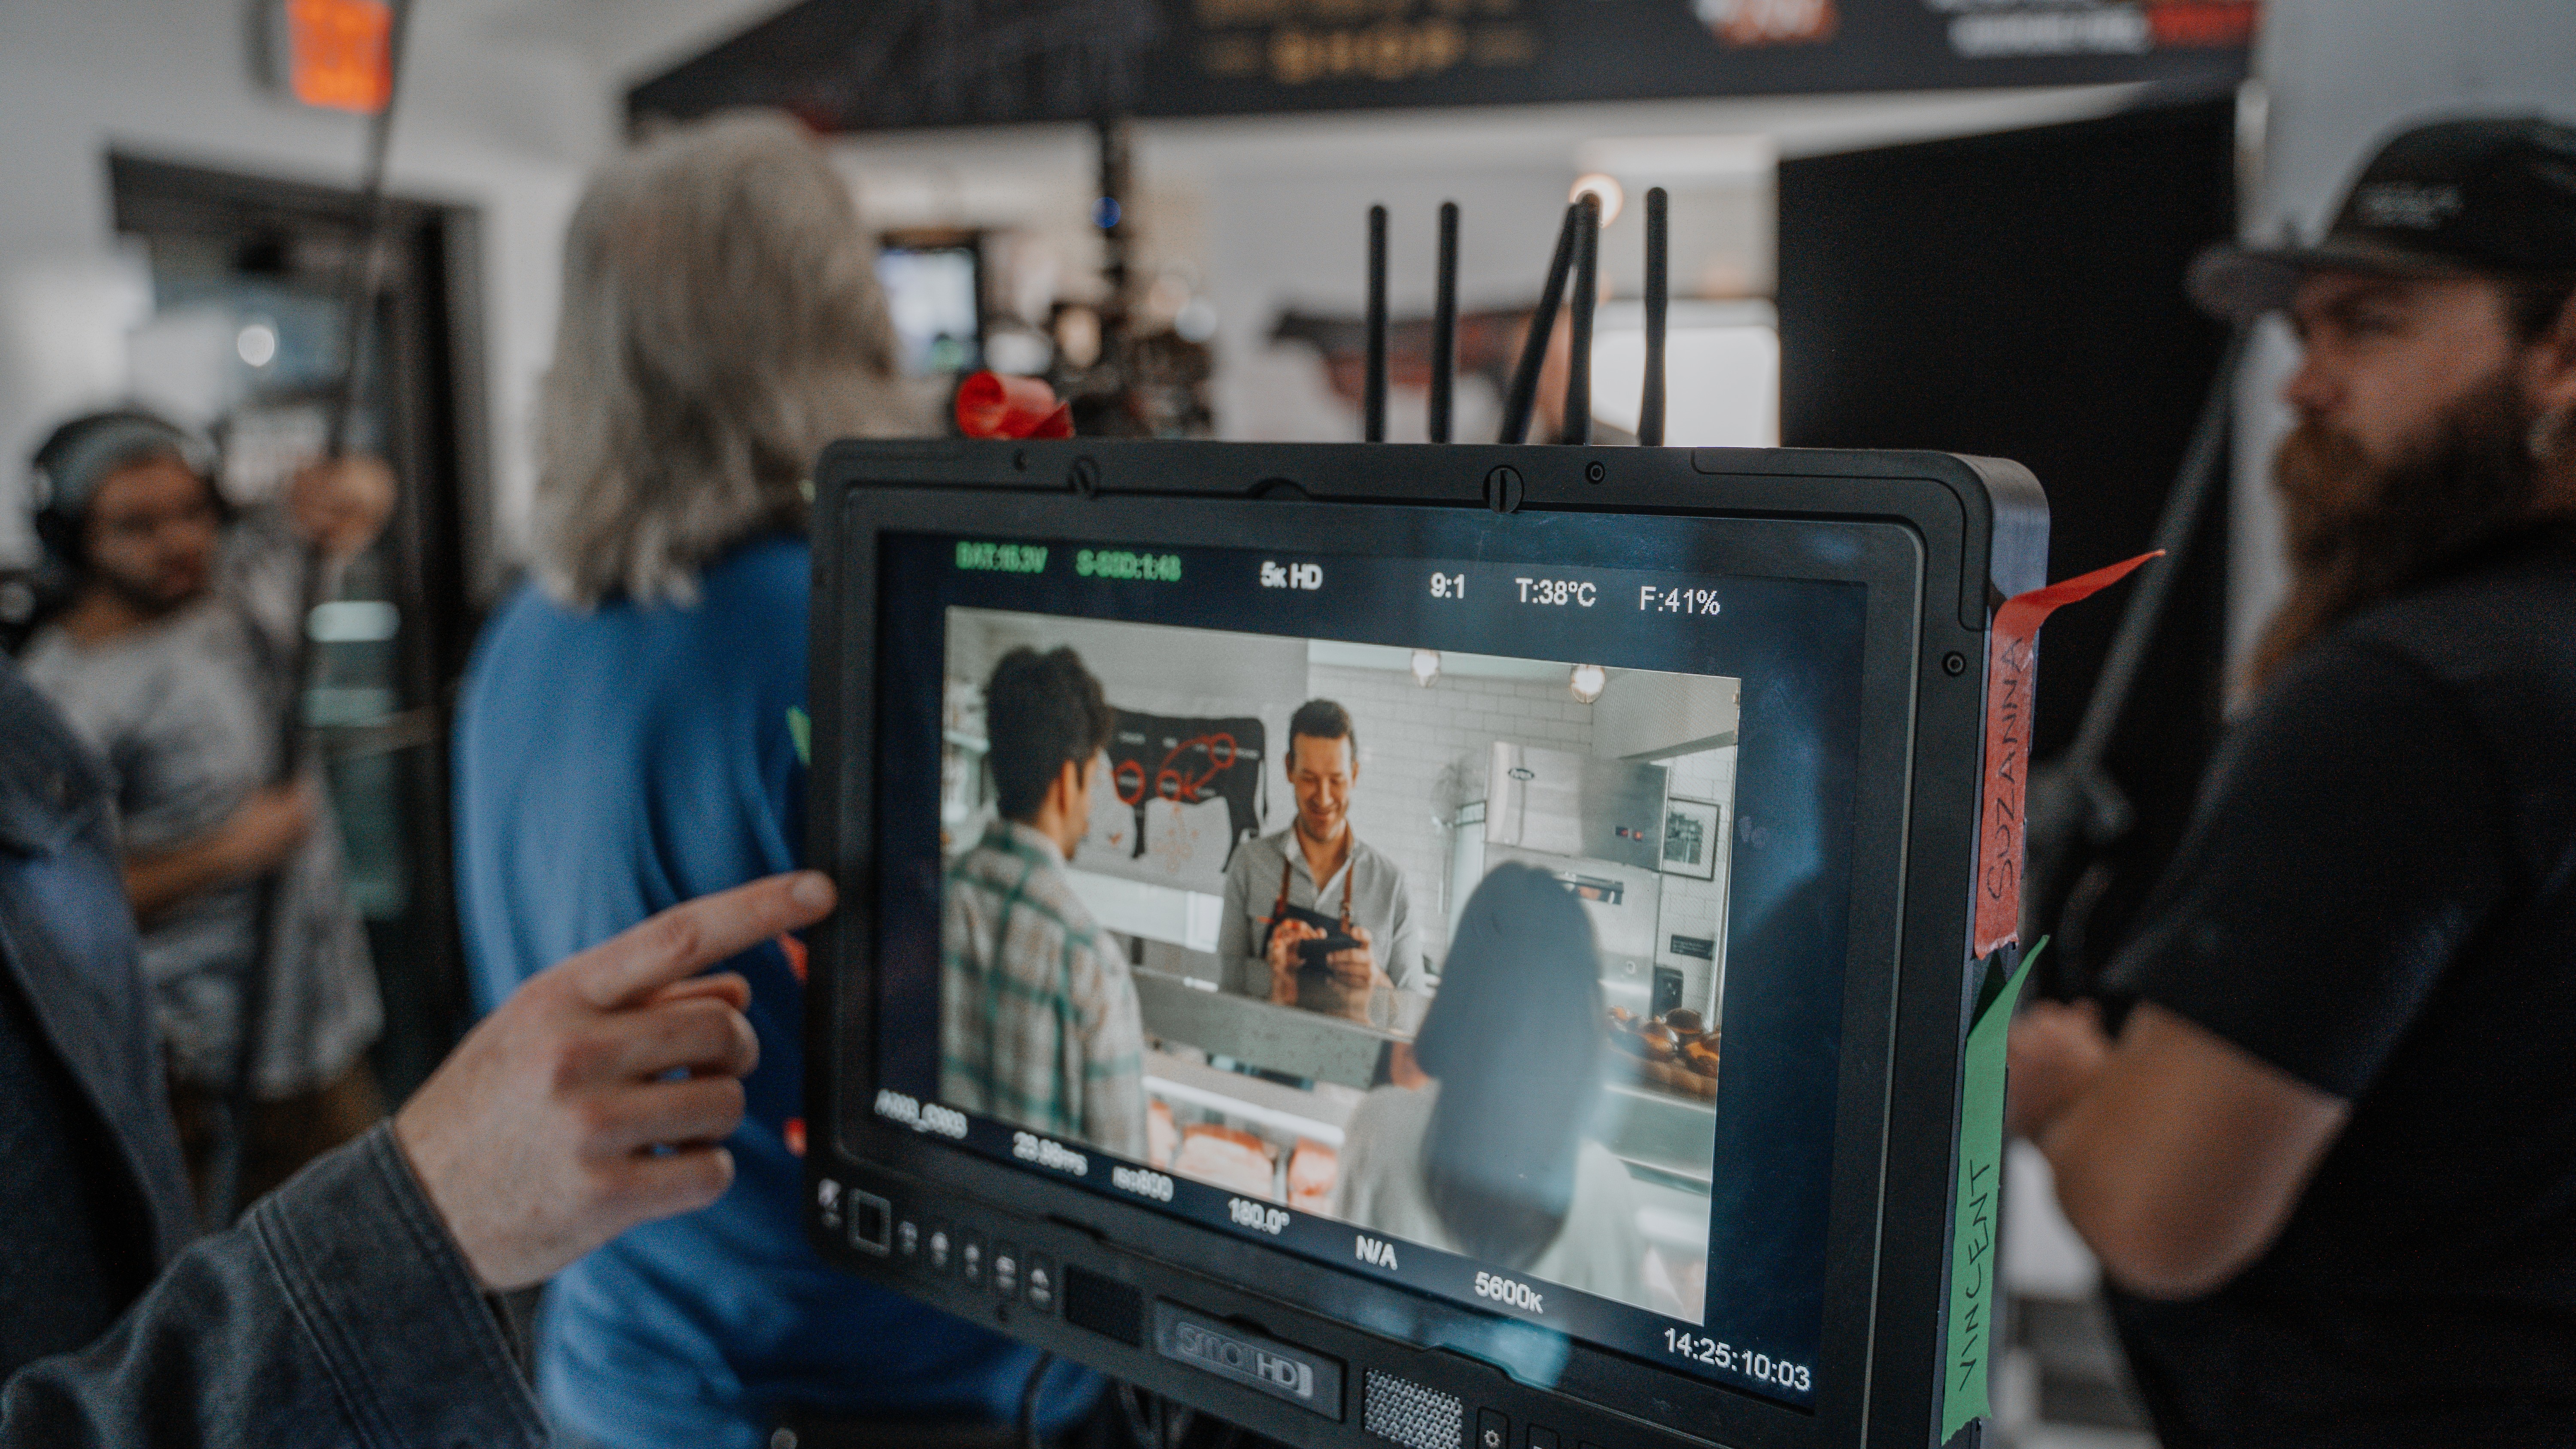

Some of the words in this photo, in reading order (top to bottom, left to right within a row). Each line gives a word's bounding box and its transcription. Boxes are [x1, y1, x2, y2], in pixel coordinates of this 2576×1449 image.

[1290, 563, 1323, 590] HD
[1430, 572, 1464, 599] 9:1
[1516, 578, 1596, 607] T:38°C
[1640, 586, 1720, 615] F:41%
[1986, 637, 2023, 900] SUZANNA
[1356, 1236, 1397, 1270] N/A
[1959, 1160, 1990, 1391] VINCENT
[1665, 1328, 1810, 1391] 14:25:10:03
